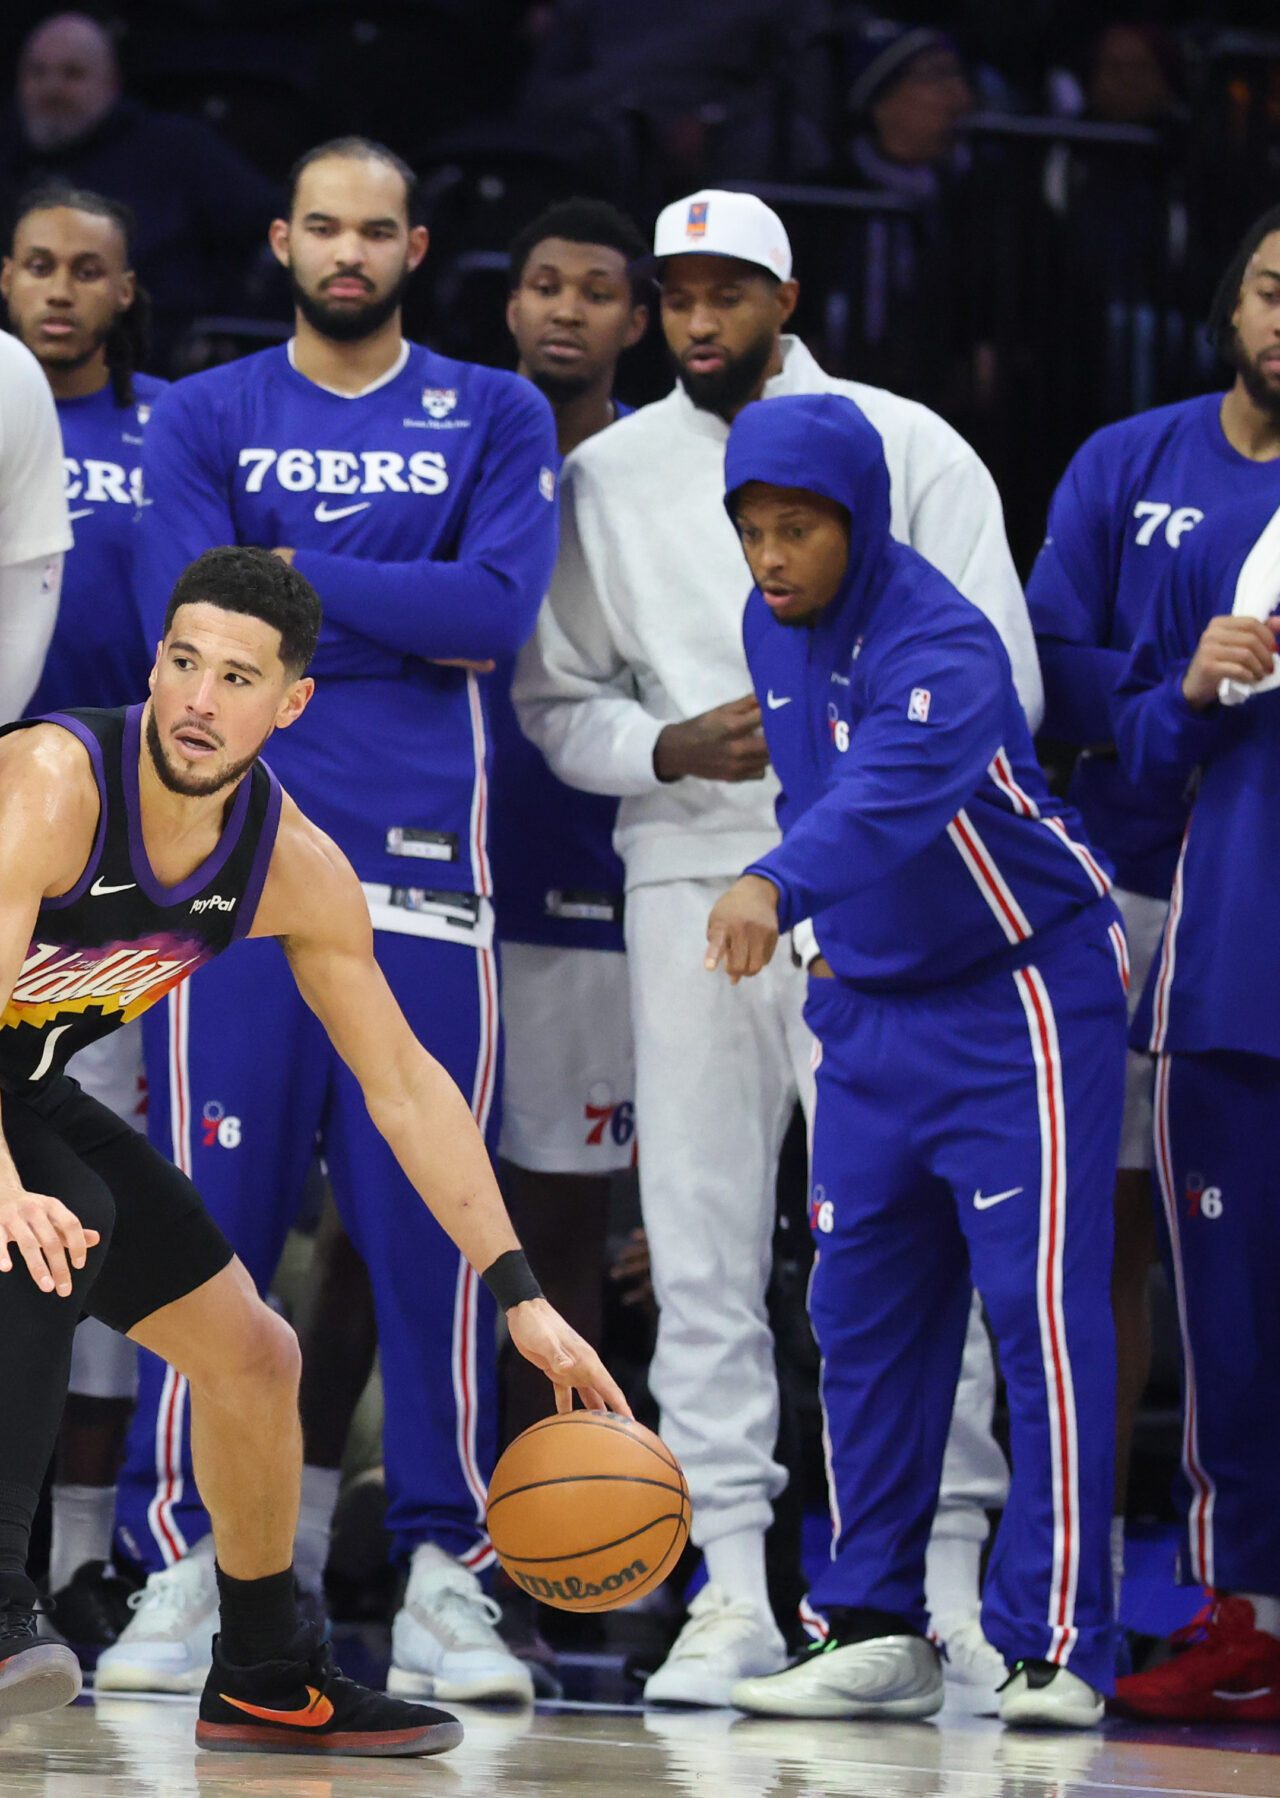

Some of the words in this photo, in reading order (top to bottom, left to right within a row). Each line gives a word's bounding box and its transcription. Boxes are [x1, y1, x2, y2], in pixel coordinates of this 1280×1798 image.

[238, 448, 449, 496] 76ERS
[189, 894, 236, 914] PayPal
[12, 942, 200, 1008] Valley
[28, 1023, 74, 1081] 1
[202, 1115, 242, 1150] 76
[584, 1101, 635, 1147] 76
[809, 1200, 835, 1234] 76
[1184, 1186, 1224, 1220] 76
[514, 1558, 648, 1601] Wilson
